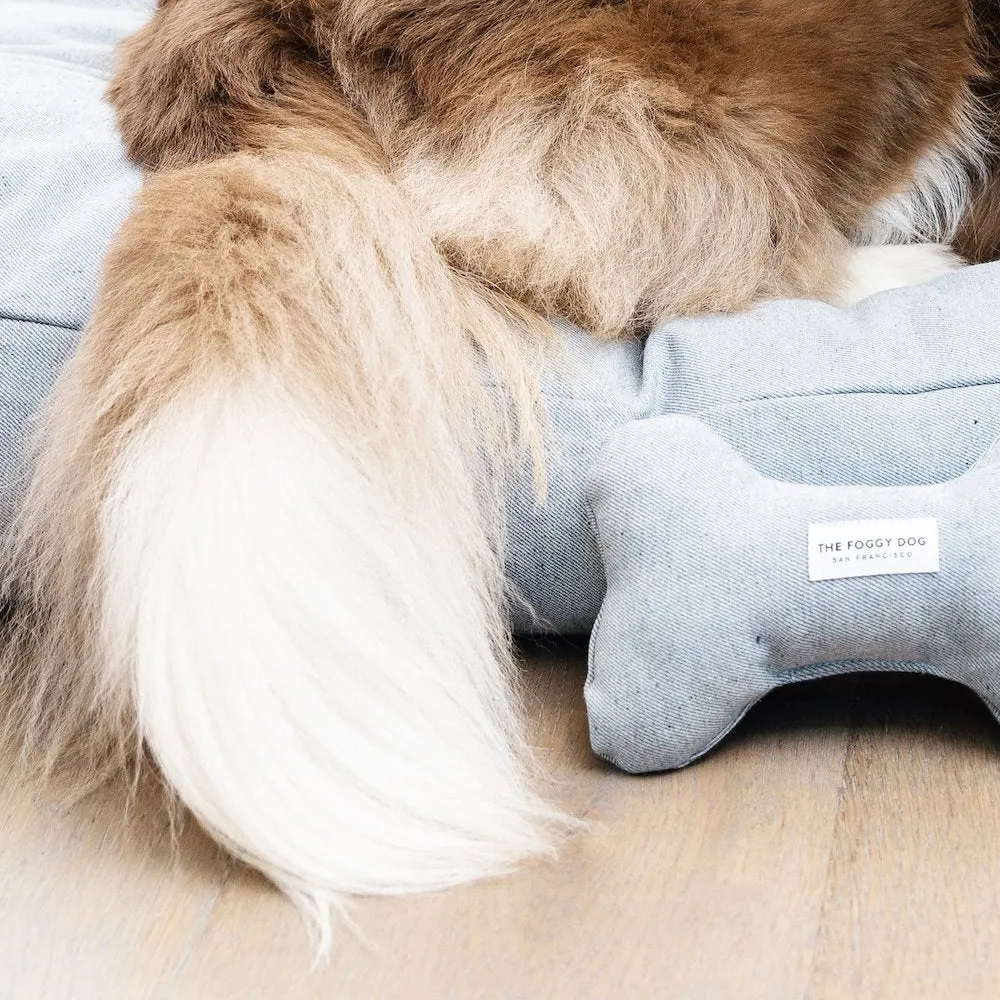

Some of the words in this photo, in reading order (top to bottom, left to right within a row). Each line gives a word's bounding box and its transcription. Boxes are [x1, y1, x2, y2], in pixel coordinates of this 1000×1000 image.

[818, 542, 842, 552] THE
[847, 538, 892, 550] FOGGY
[898, 536, 926, 546] DOG
[832, 556, 850, 564] SAN
[856, 551, 913, 561] FRANCISCO
